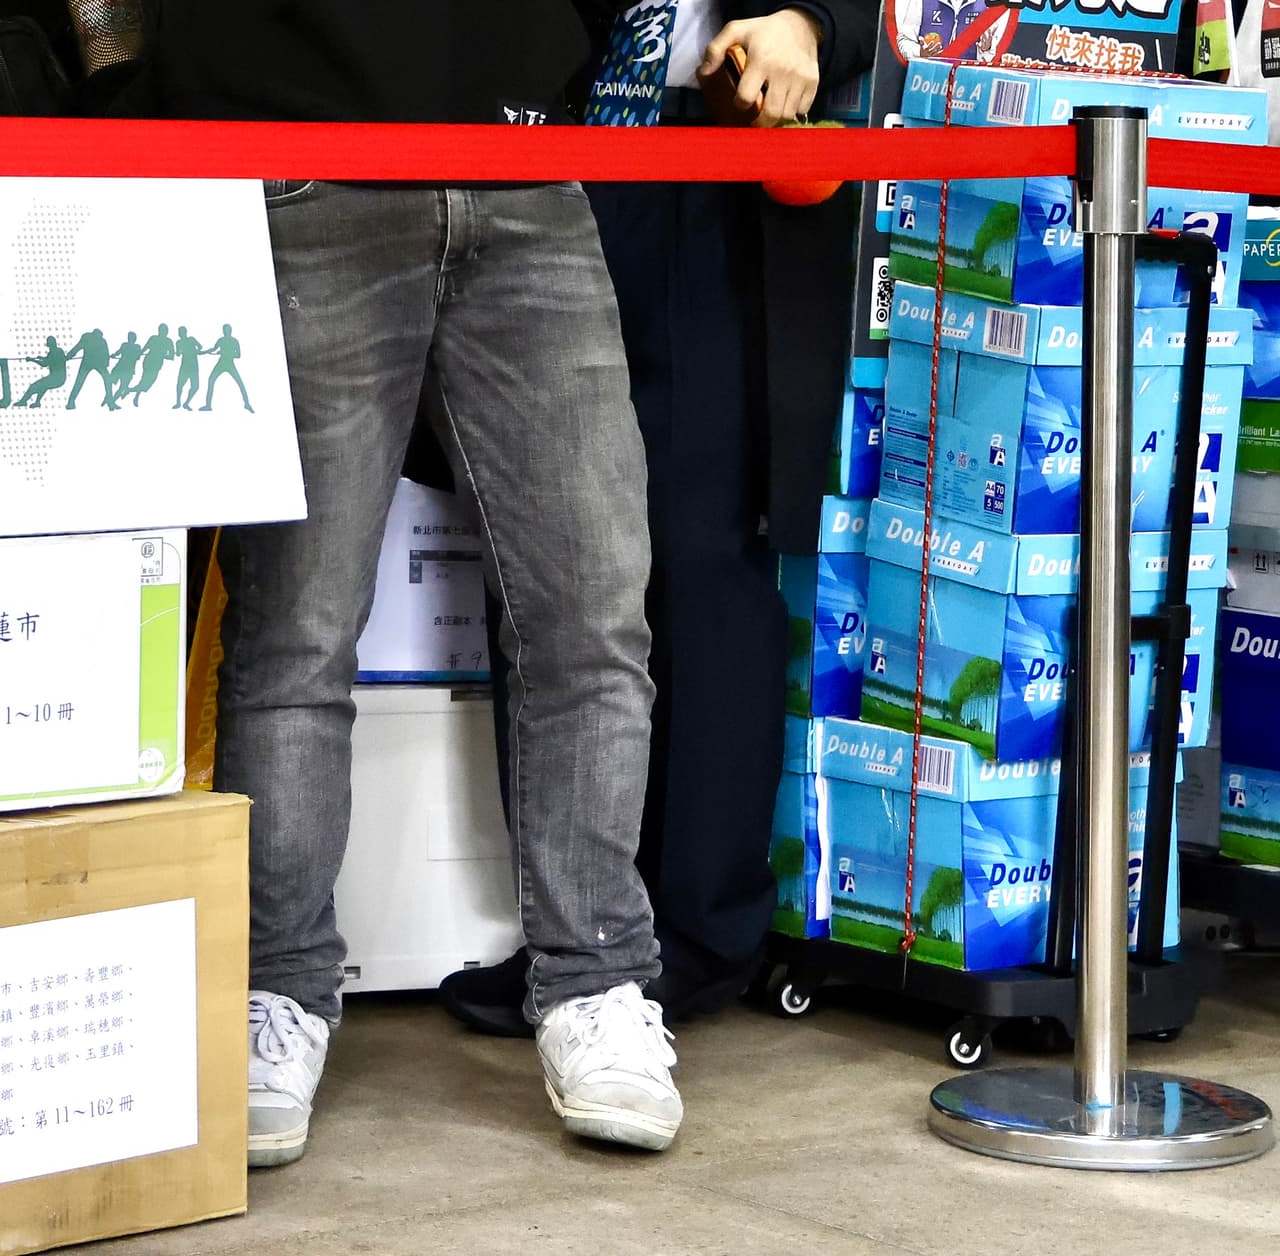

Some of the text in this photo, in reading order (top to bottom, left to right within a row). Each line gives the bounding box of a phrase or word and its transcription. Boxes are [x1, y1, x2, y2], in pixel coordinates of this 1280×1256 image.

[1046, 26, 1145, 72] 快來找我
[594, 81, 653, 100] TAIWAN
[910, 75, 981, 100] Double A
[1148, 104, 1243, 127] A EVERYDAY
[898, 299, 975, 329] Double A
[1138, 326, 1230, 348] A EVEDAY
[1141, 431, 1158, 453] A
[886, 518, 987, 563] Double A
[827, 734, 904, 766] Double A
[988, 863, 1052, 886] Doub
[987, 884, 1052, 909] EVERY
